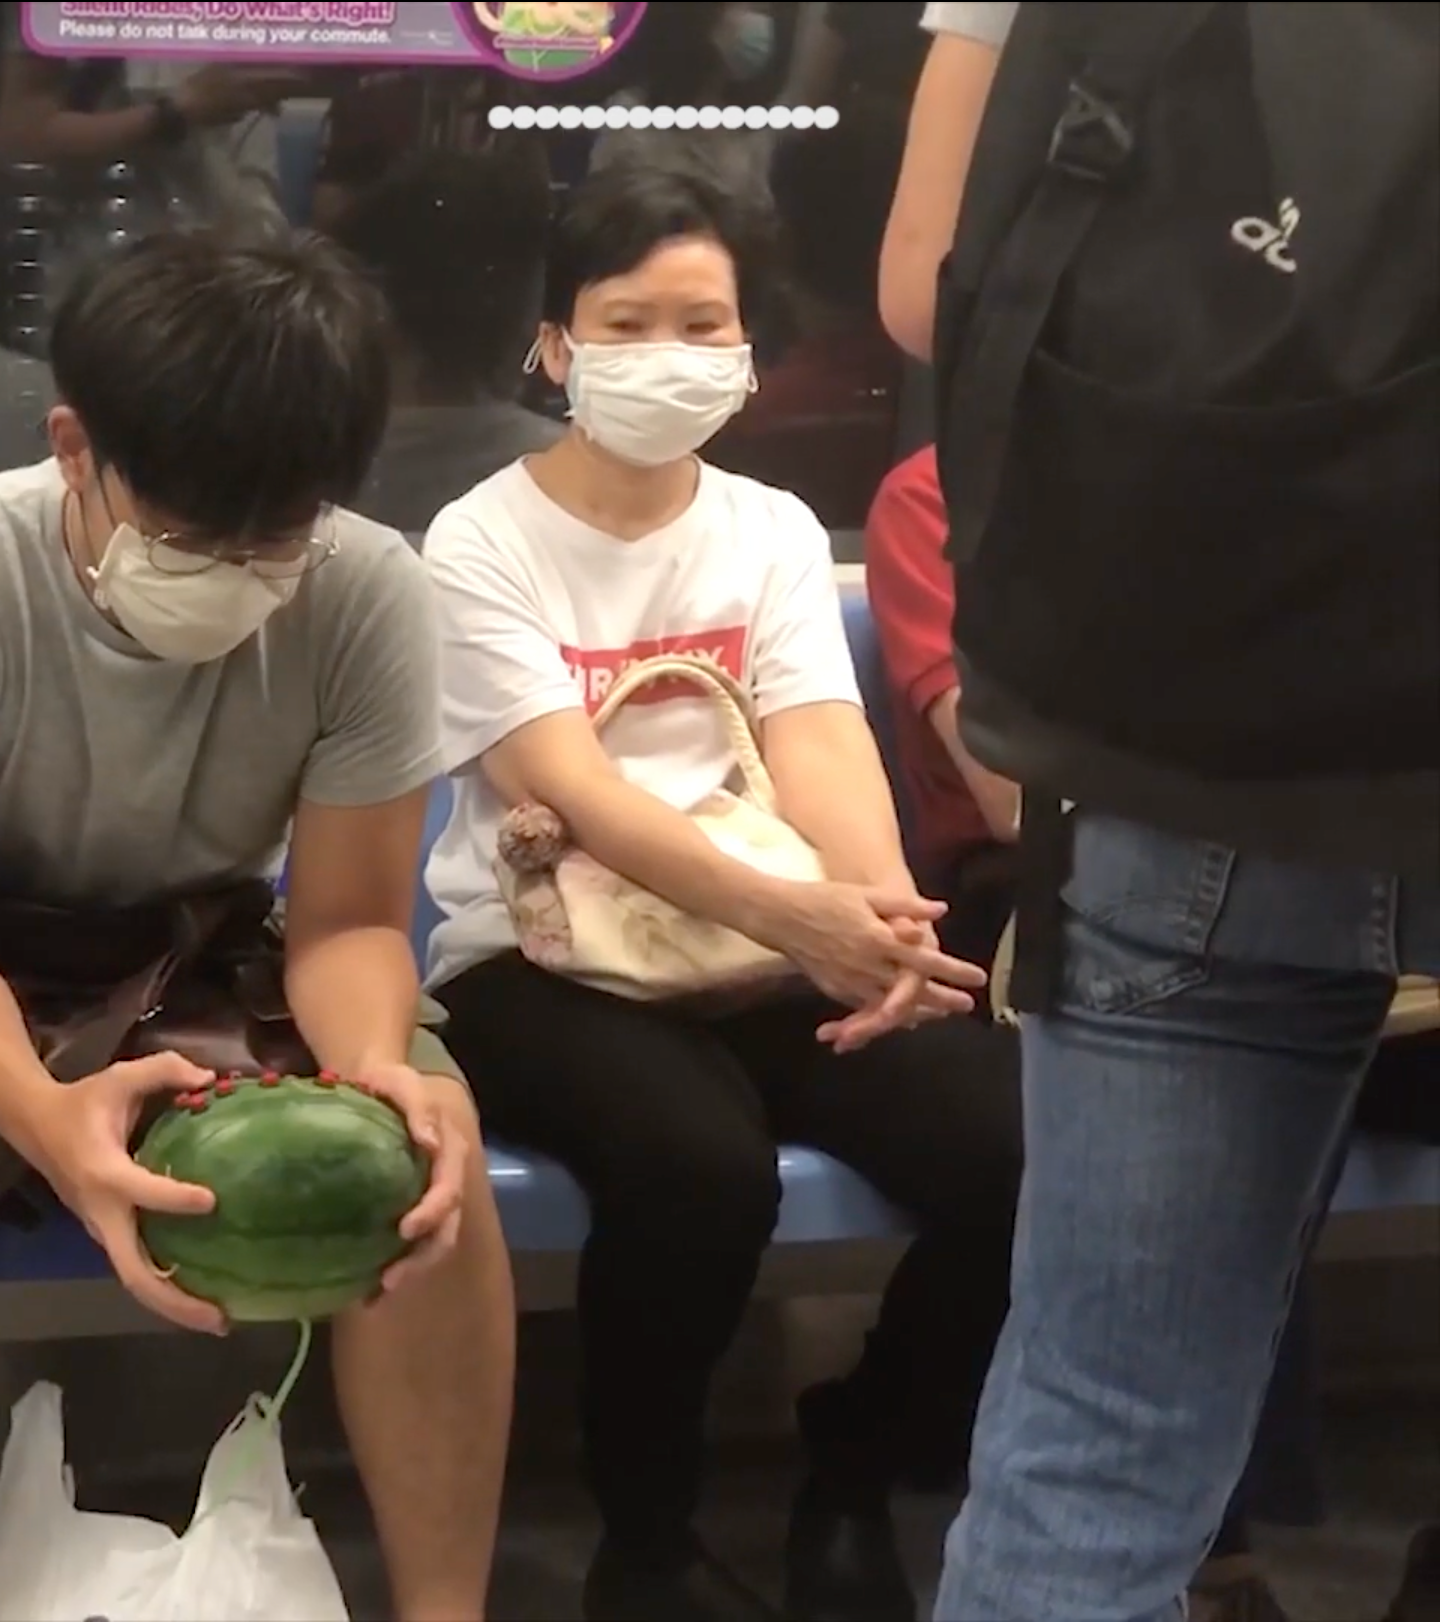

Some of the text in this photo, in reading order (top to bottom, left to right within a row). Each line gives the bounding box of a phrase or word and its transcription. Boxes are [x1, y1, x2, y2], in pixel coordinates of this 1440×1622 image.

[60, 20, 391, 43] Please do not talk during your commute.
